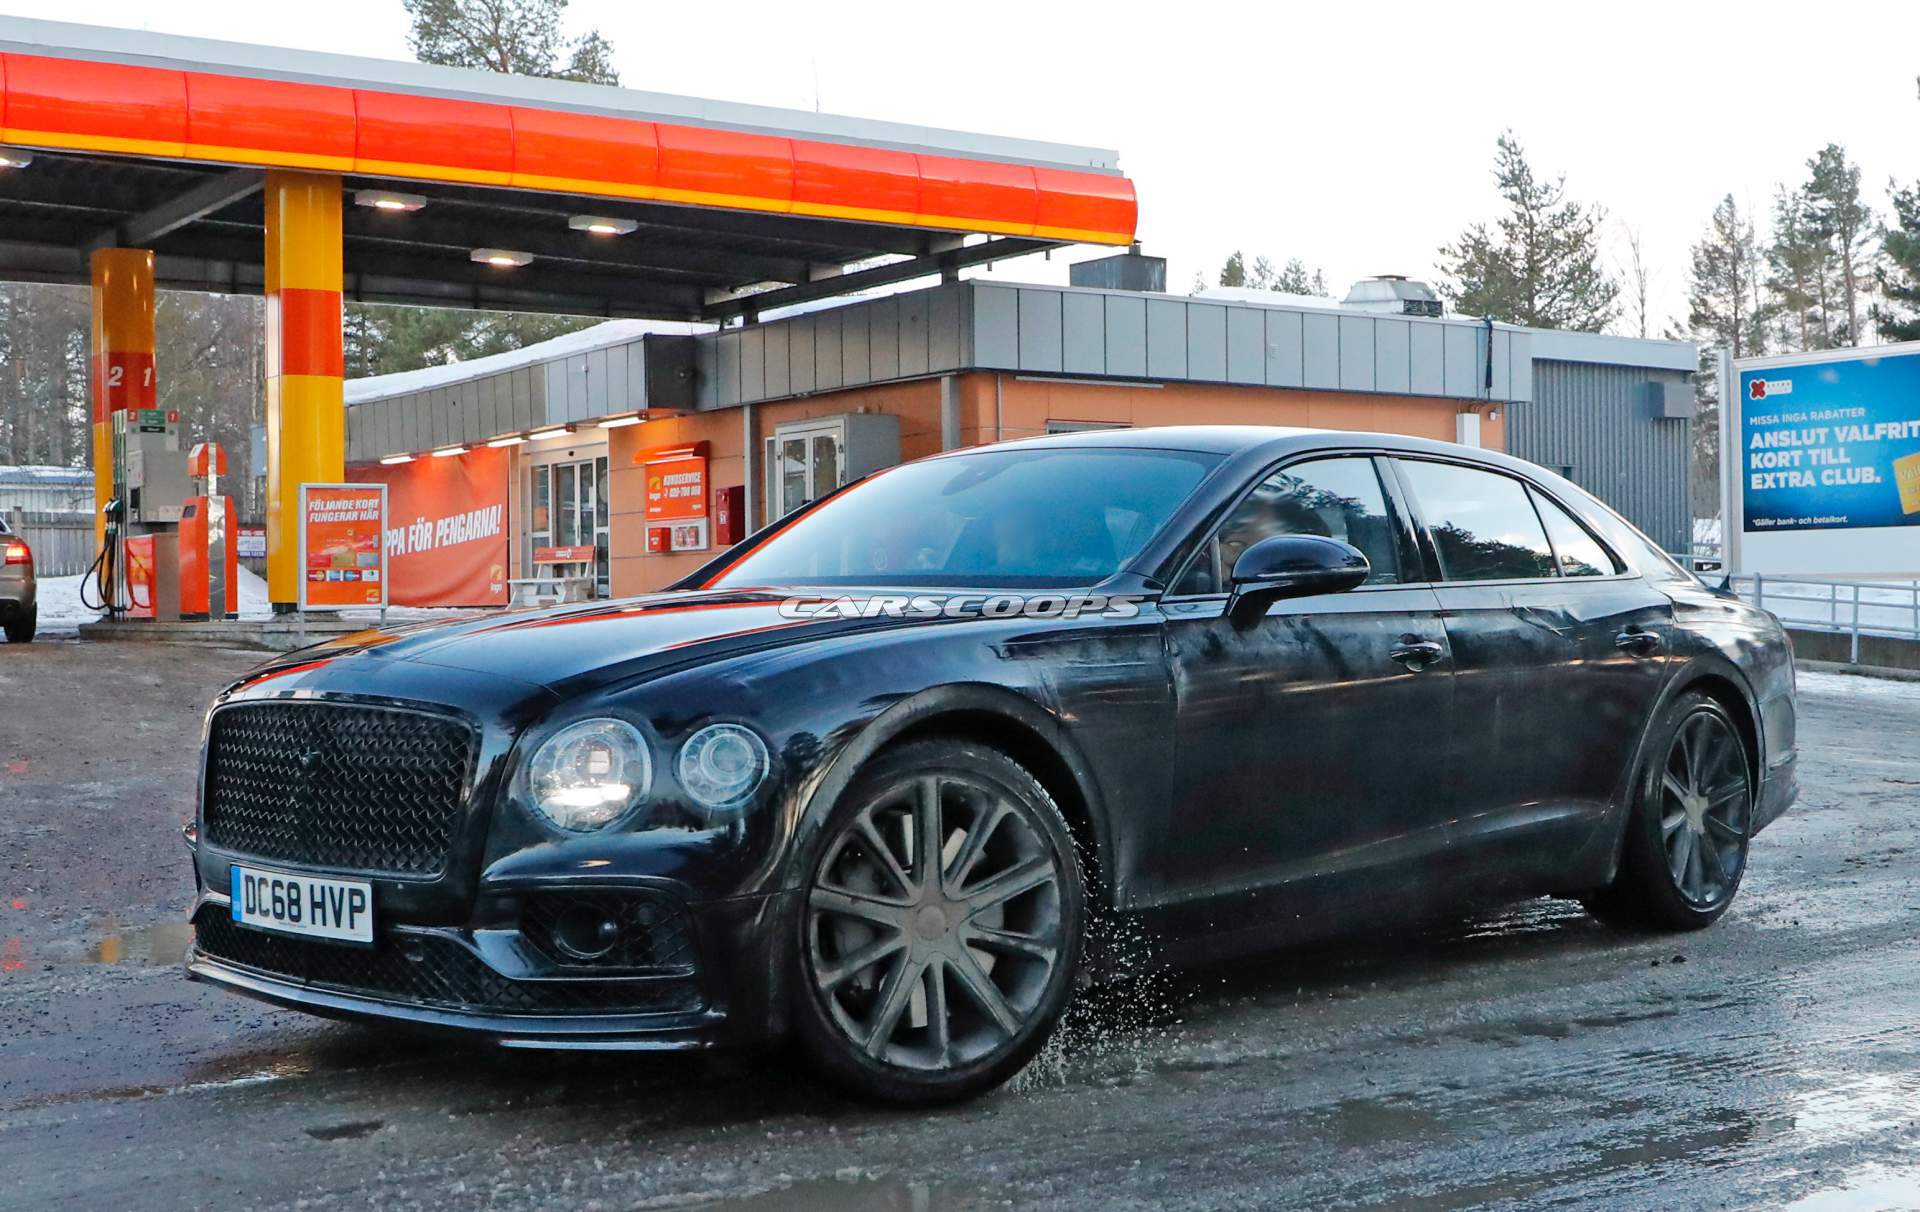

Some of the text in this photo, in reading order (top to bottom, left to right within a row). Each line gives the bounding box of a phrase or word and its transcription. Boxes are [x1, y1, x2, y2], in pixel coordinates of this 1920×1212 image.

[108, 366, 152, 387] 2 1
[1750, 407, 1866, 426] MISSA INGA RABATTER
[1750, 427, 1829, 449] ANSLUT
[1751, 447, 1850, 469] KORT TILL
[1751, 467, 1882, 490] EXTRA CLUB.
[309, 498, 379, 511] FÖLJANDE KORT
[310, 509, 379, 522] FUNGERAR HÄR
[1798, 516, 1812, 525] och
[408, 517, 433, 554] FÖR
[435, 504, 502, 549] PENGARNA!
[245, 874, 366, 930] DC68 HVP
